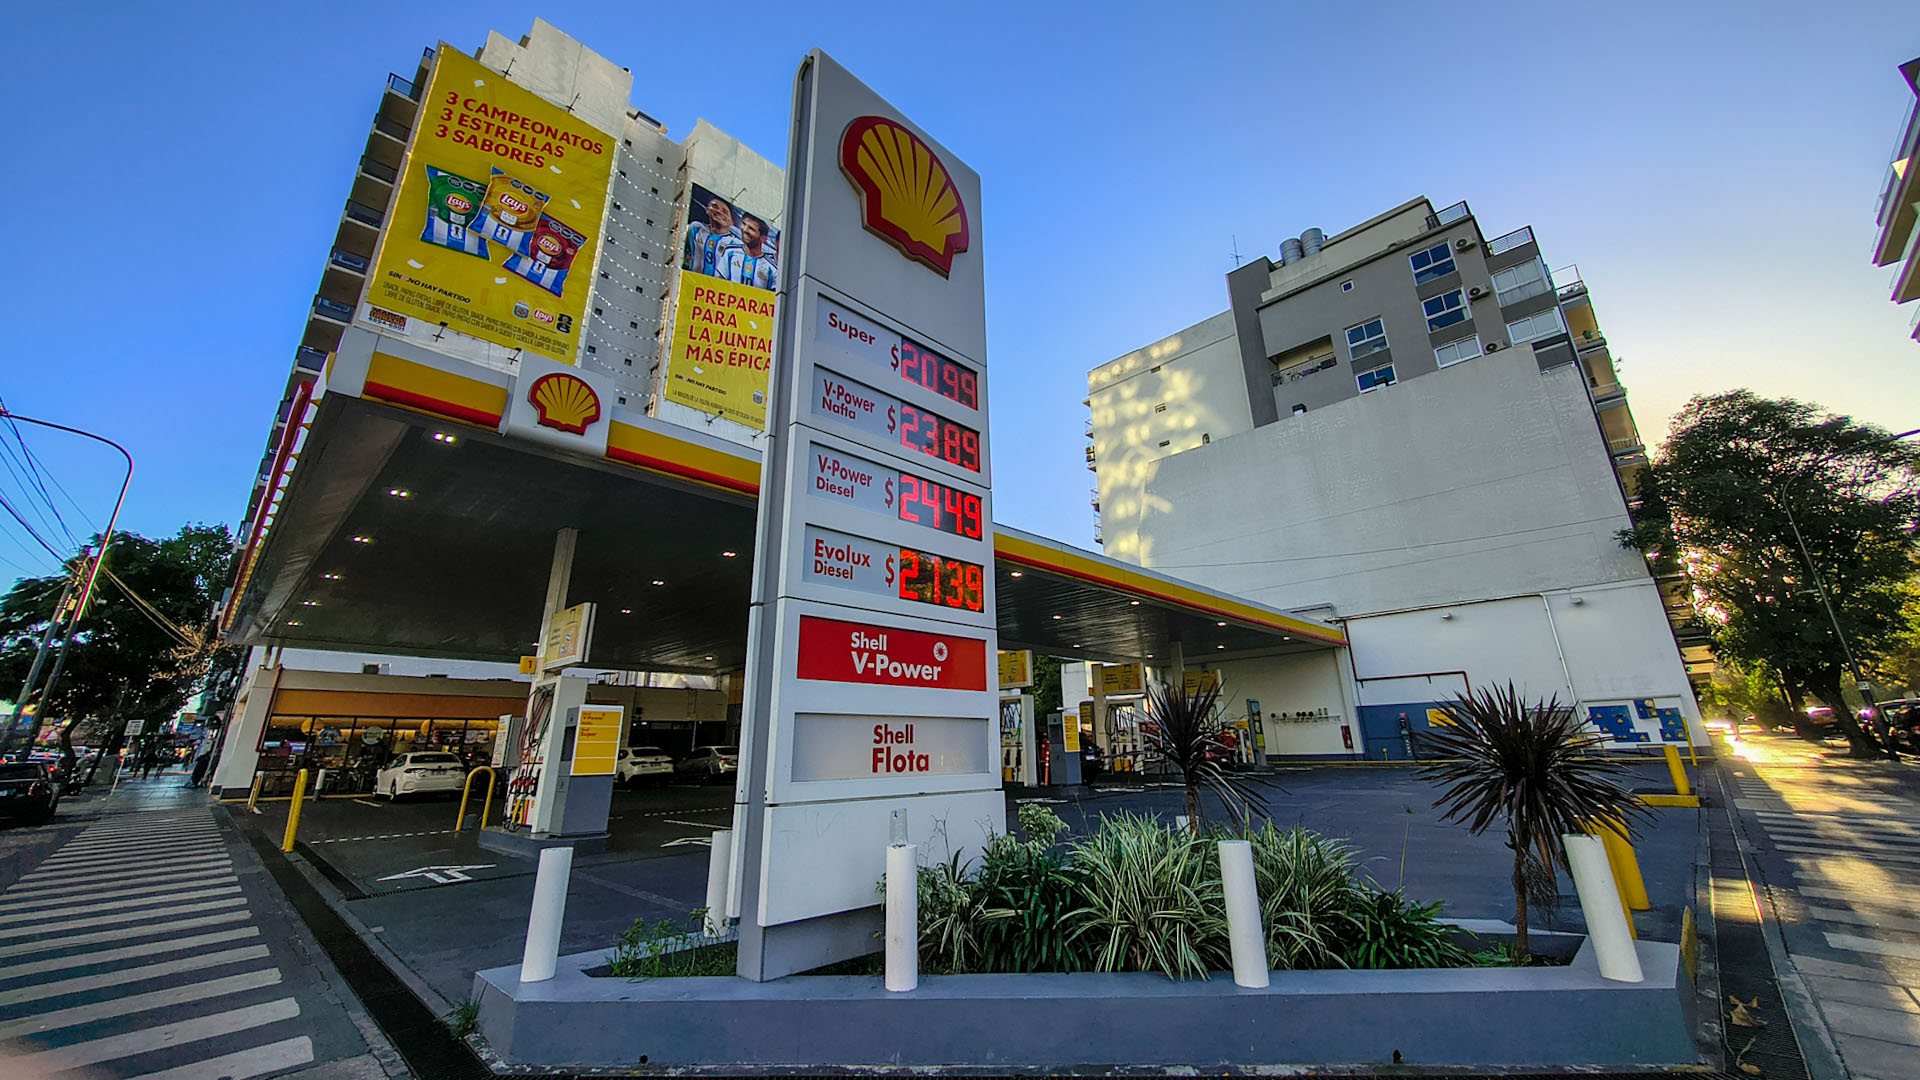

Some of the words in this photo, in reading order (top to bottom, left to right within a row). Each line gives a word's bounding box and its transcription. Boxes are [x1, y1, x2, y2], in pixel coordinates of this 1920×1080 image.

[440, 107, 453, 122] 3
[458, 112, 564, 158] ESTRELLAS
[446, 91, 459, 106] 3
[463, 98, 603, 155] CAMPEONATOS
[435, 124, 449, 138] 3
[452, 129, 545, 168] SABORES
[388, 270, 401, 280] SIN
[408, 277, 421, 286] NO
[421, 282, 438, 292] HAY
[438, 288, 471, 303] PARTIDO
[691, 306, 738, 328] PARA
[828, 312, 876, 345] Super
[689, 325, 710, 343] LA
[686, 344, 724, 364] MÁS
[728, 348, 771, 371] ÉPICA
[695, 380, 706, 389] HAY
[705, 384, 727, 396] PARTIDO
[891, 344, 899, 371] $
[901, 343, 977, 411] 2099
[822, 396, 856, 420] Nafta
[823, 379, 875, 413] V-Power
[887, 405, 896, 434] $
[901, 407, 980, 473] 2389
[818, 454, 873, 487] V-Power
[816, 477, 854, 499] Diesel
[884, 477, 894, 509] $
[900, 474, 981, 539] 2449
[814, 538, 871, 567] Evolux
[814, 560, 854, 580] Diesel
[885, 554, 895, 588] $
[899, 550, 982, 612] 2139
[851, 631, 887, 651] Shell
[528, 660, 533, 669] 1
[851, 651, 942, 681] V-Power
[873, 723, 914, 745] Shell
[872, 746, 929, 773] Flota
